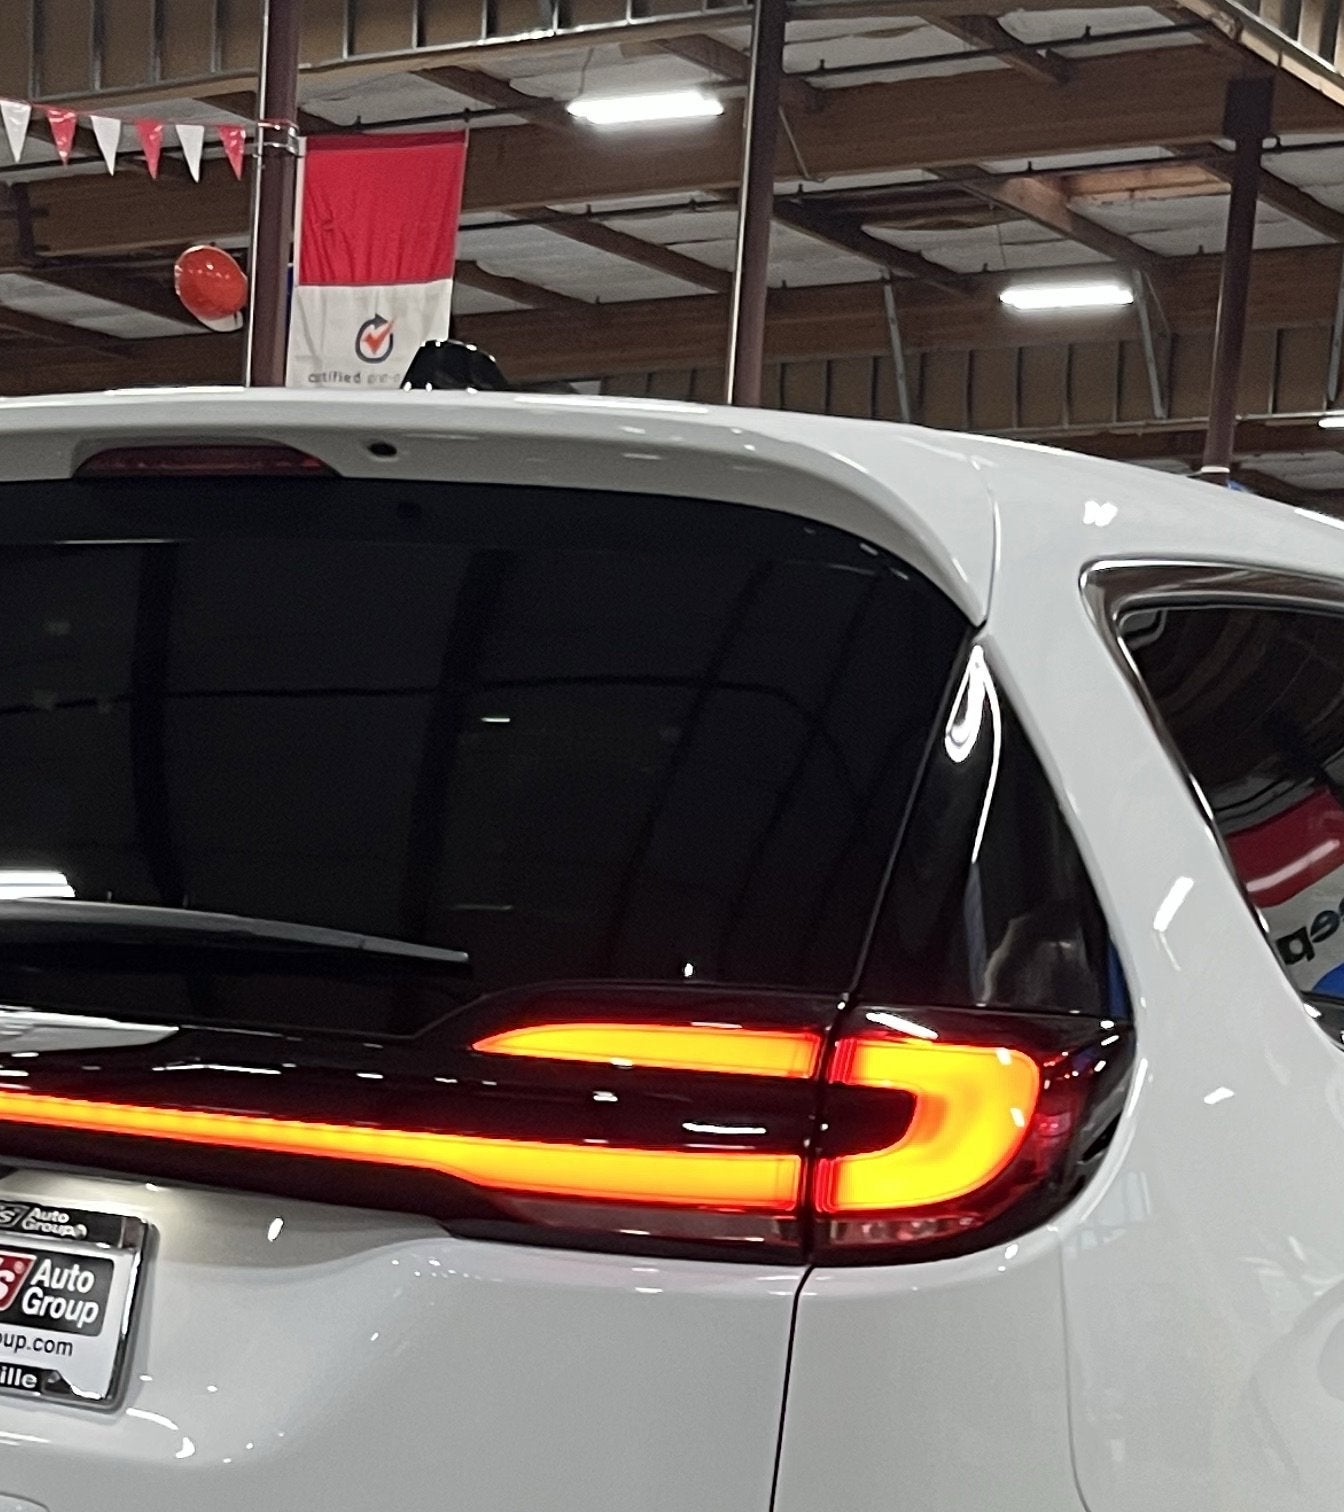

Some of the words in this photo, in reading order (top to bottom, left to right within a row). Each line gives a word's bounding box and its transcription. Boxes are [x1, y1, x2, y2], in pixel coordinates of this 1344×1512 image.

[21, 1219, 76, 1237] Group
[31, 1207, 70, 1223] Auto
[31, 1258, 96, 1294] Auto
[21, 1286, 100, 1329] Group
